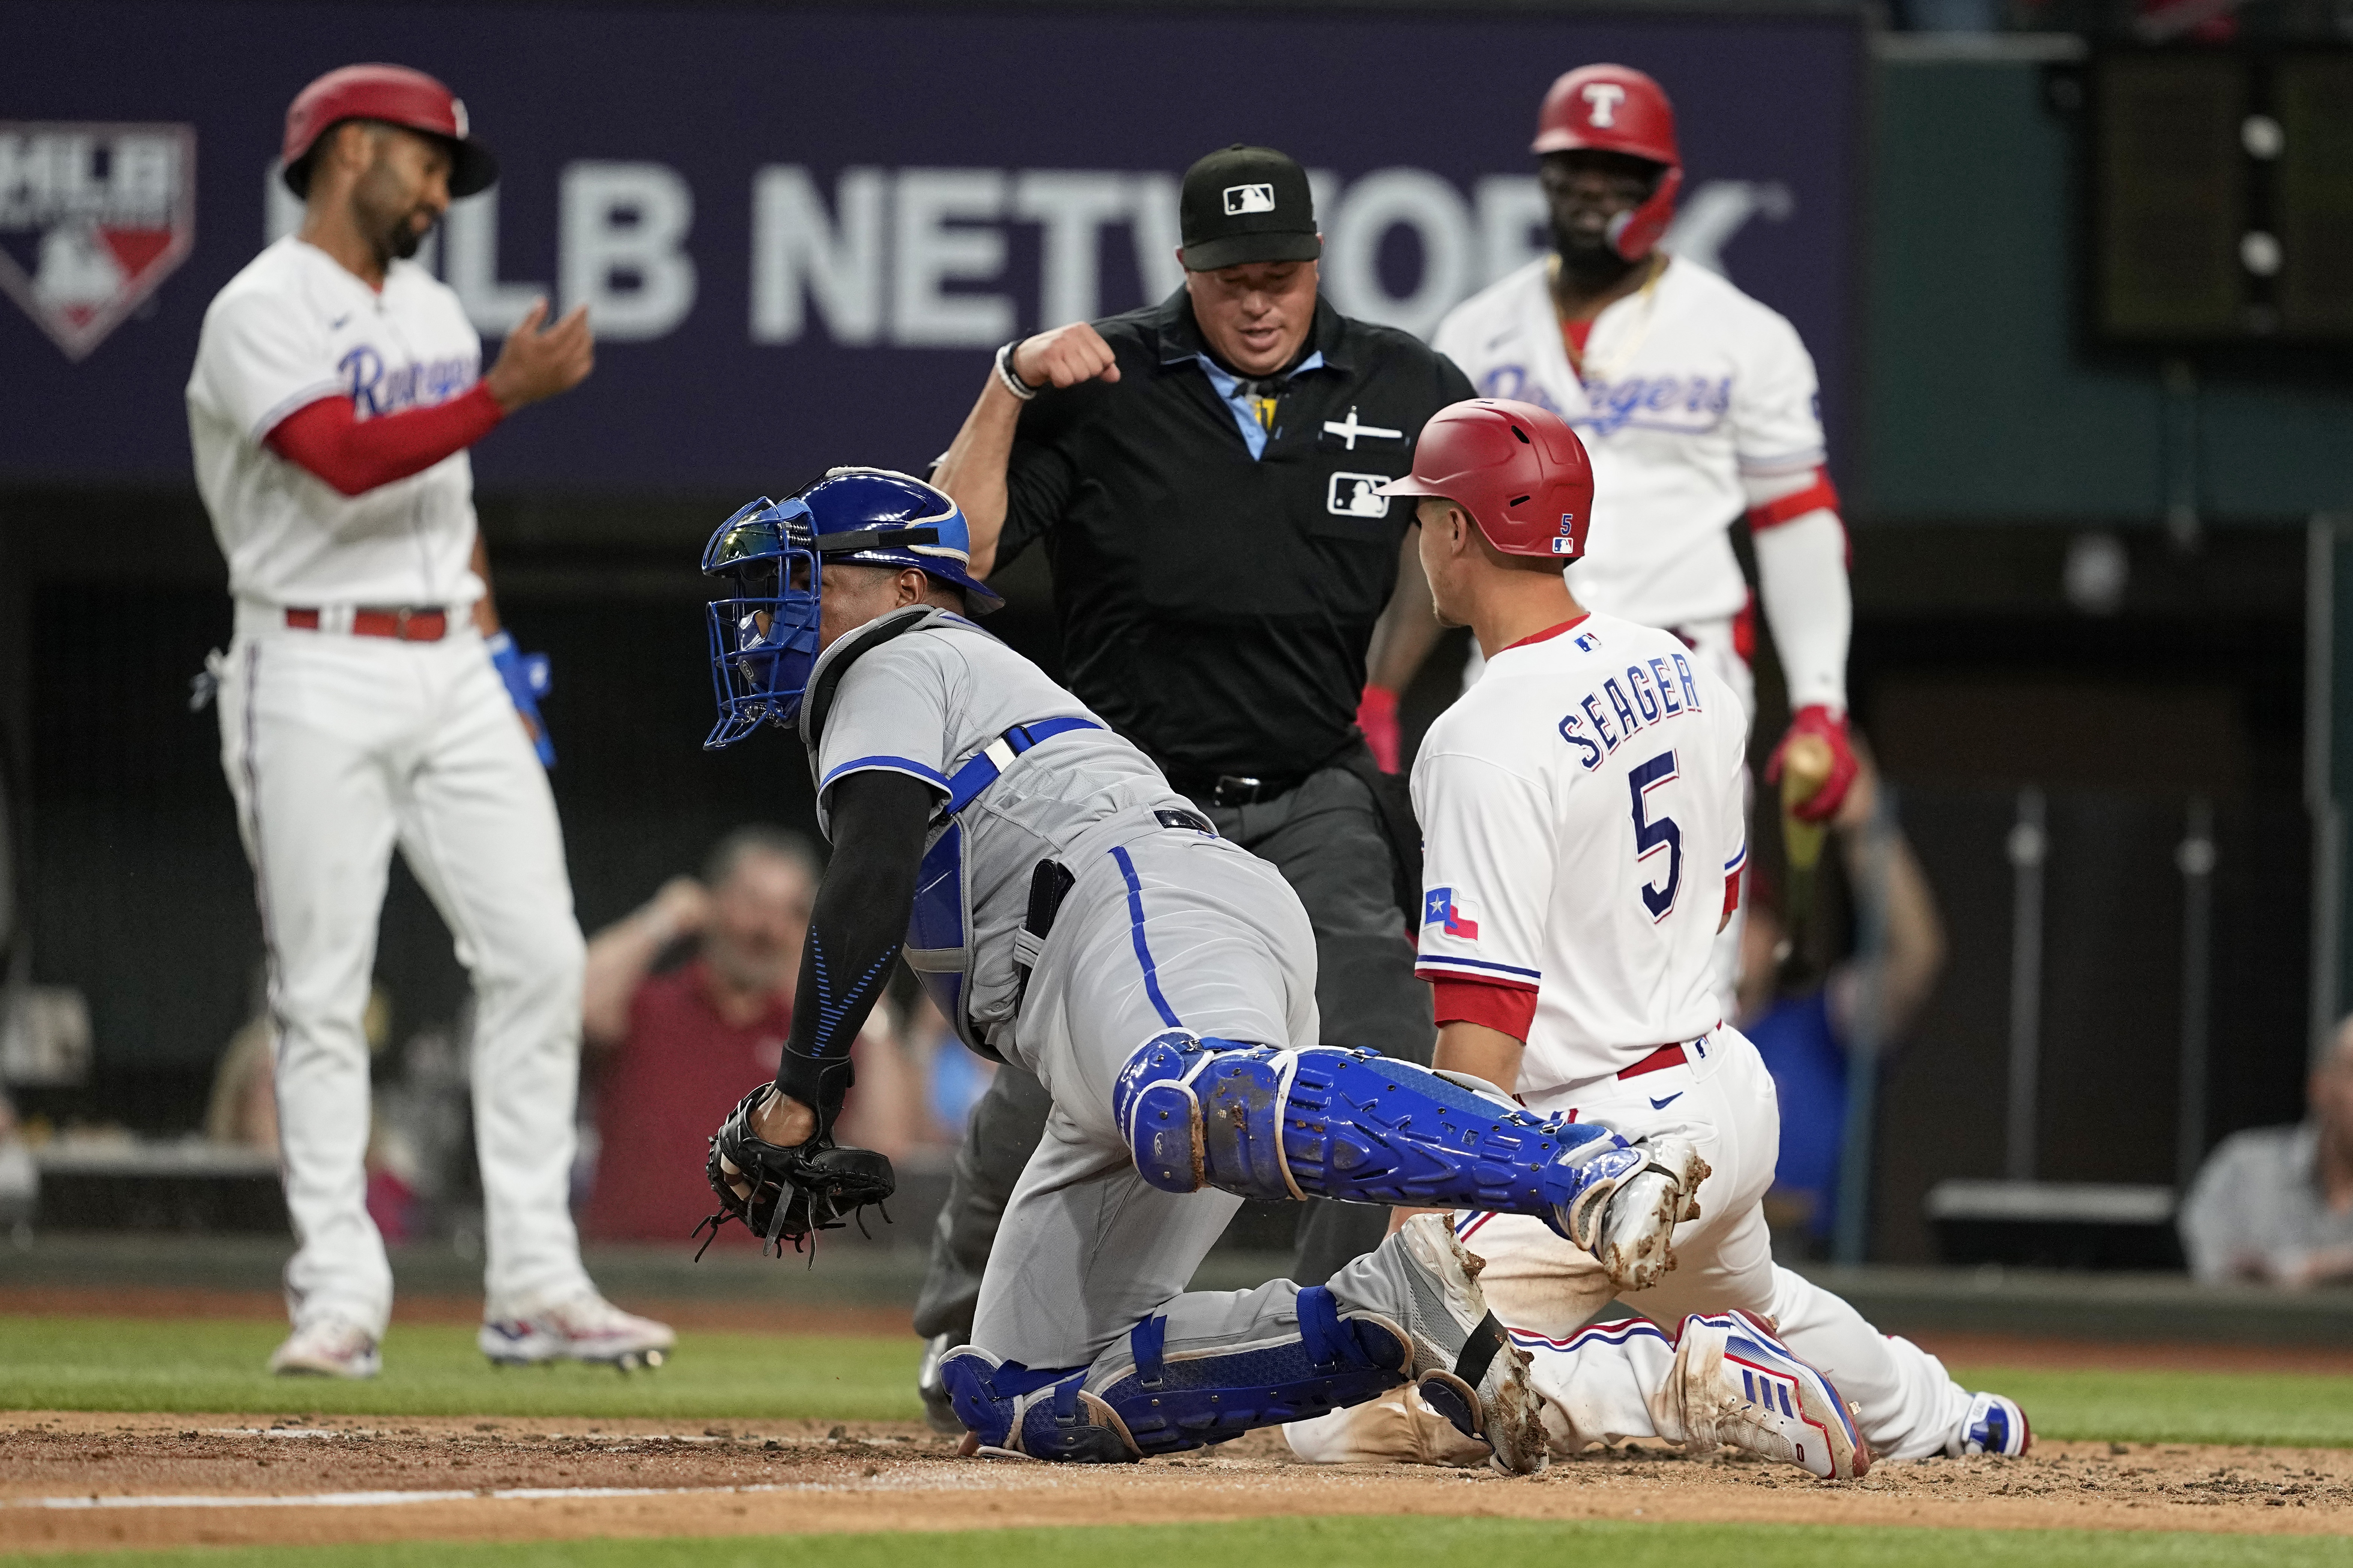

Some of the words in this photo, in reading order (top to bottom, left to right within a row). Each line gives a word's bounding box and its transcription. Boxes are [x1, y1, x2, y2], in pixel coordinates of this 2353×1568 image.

[1581, 83, 1626, 128] T
[263, 158, 698, 341] LB
[1560, 513, 1573, 536] 5
[1557, 653, 1702, 772] SEAGER
[1626, 749, 1683, 924] 5
